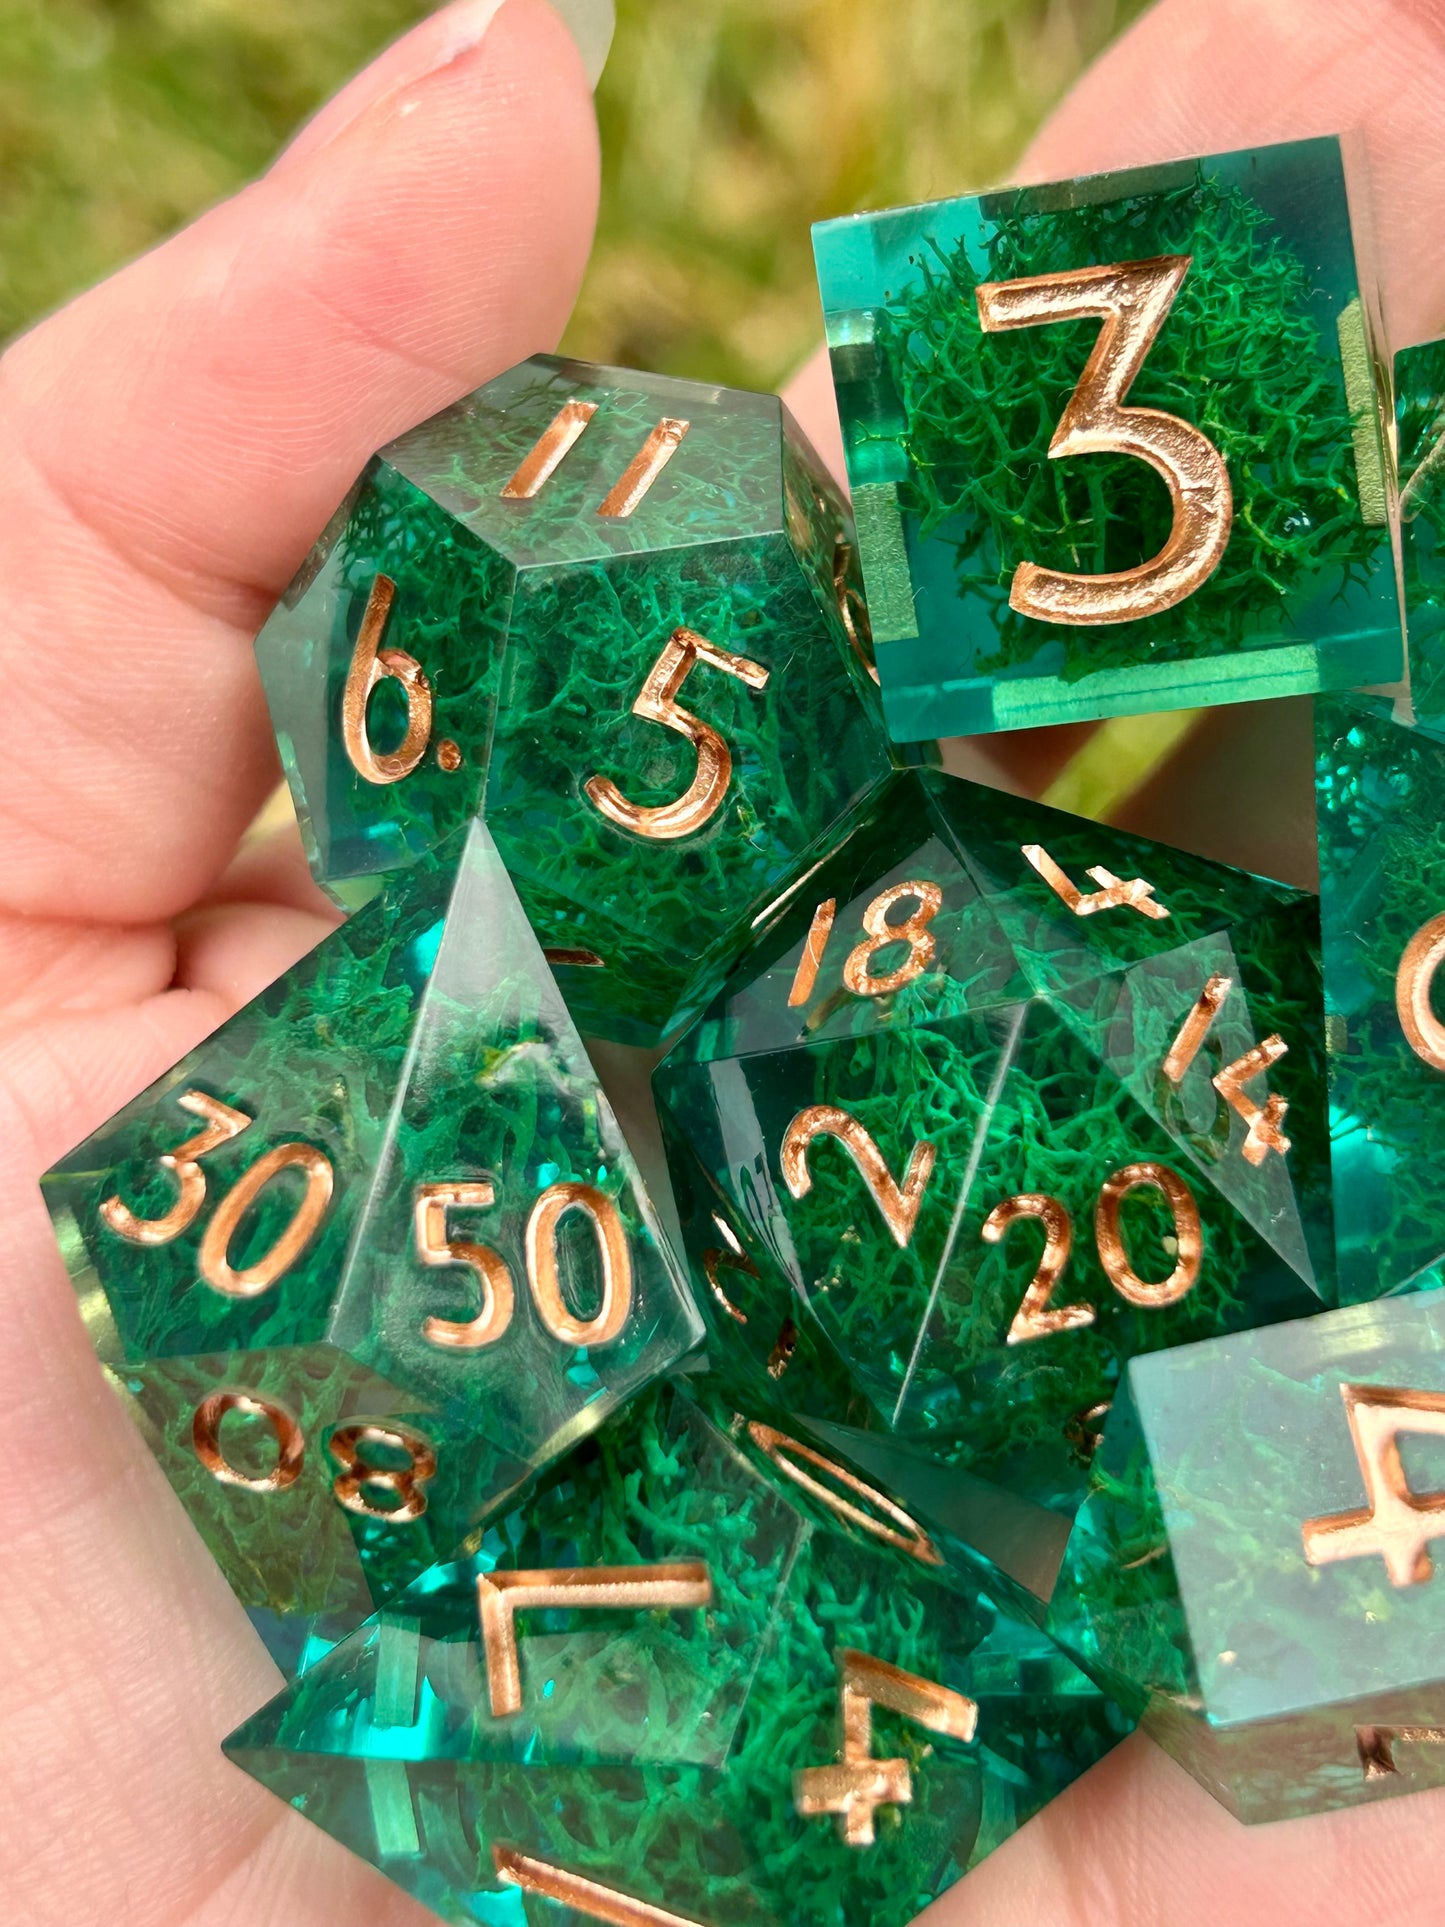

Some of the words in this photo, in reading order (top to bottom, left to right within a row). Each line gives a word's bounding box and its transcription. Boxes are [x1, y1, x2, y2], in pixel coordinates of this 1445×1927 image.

[500, 398, 690, 517] 11
[976, 255, 1233, 626] 3
[585, 625, 770, 840] 5
[788, 879, 943, 1007] 18
[1020, 843, 1170, 920] 4
[1163, 970, 1292, 1167] 14
[99, 1088, 335, 1299] 30
[780, 1104, 937, 1249] 2
[981, 1161, 1203, 1345] 20
[415, 1182, 632, 1349] 50
[478, 1558, 712, 1718] 7
[793, 1647, 979, 1846] 4
